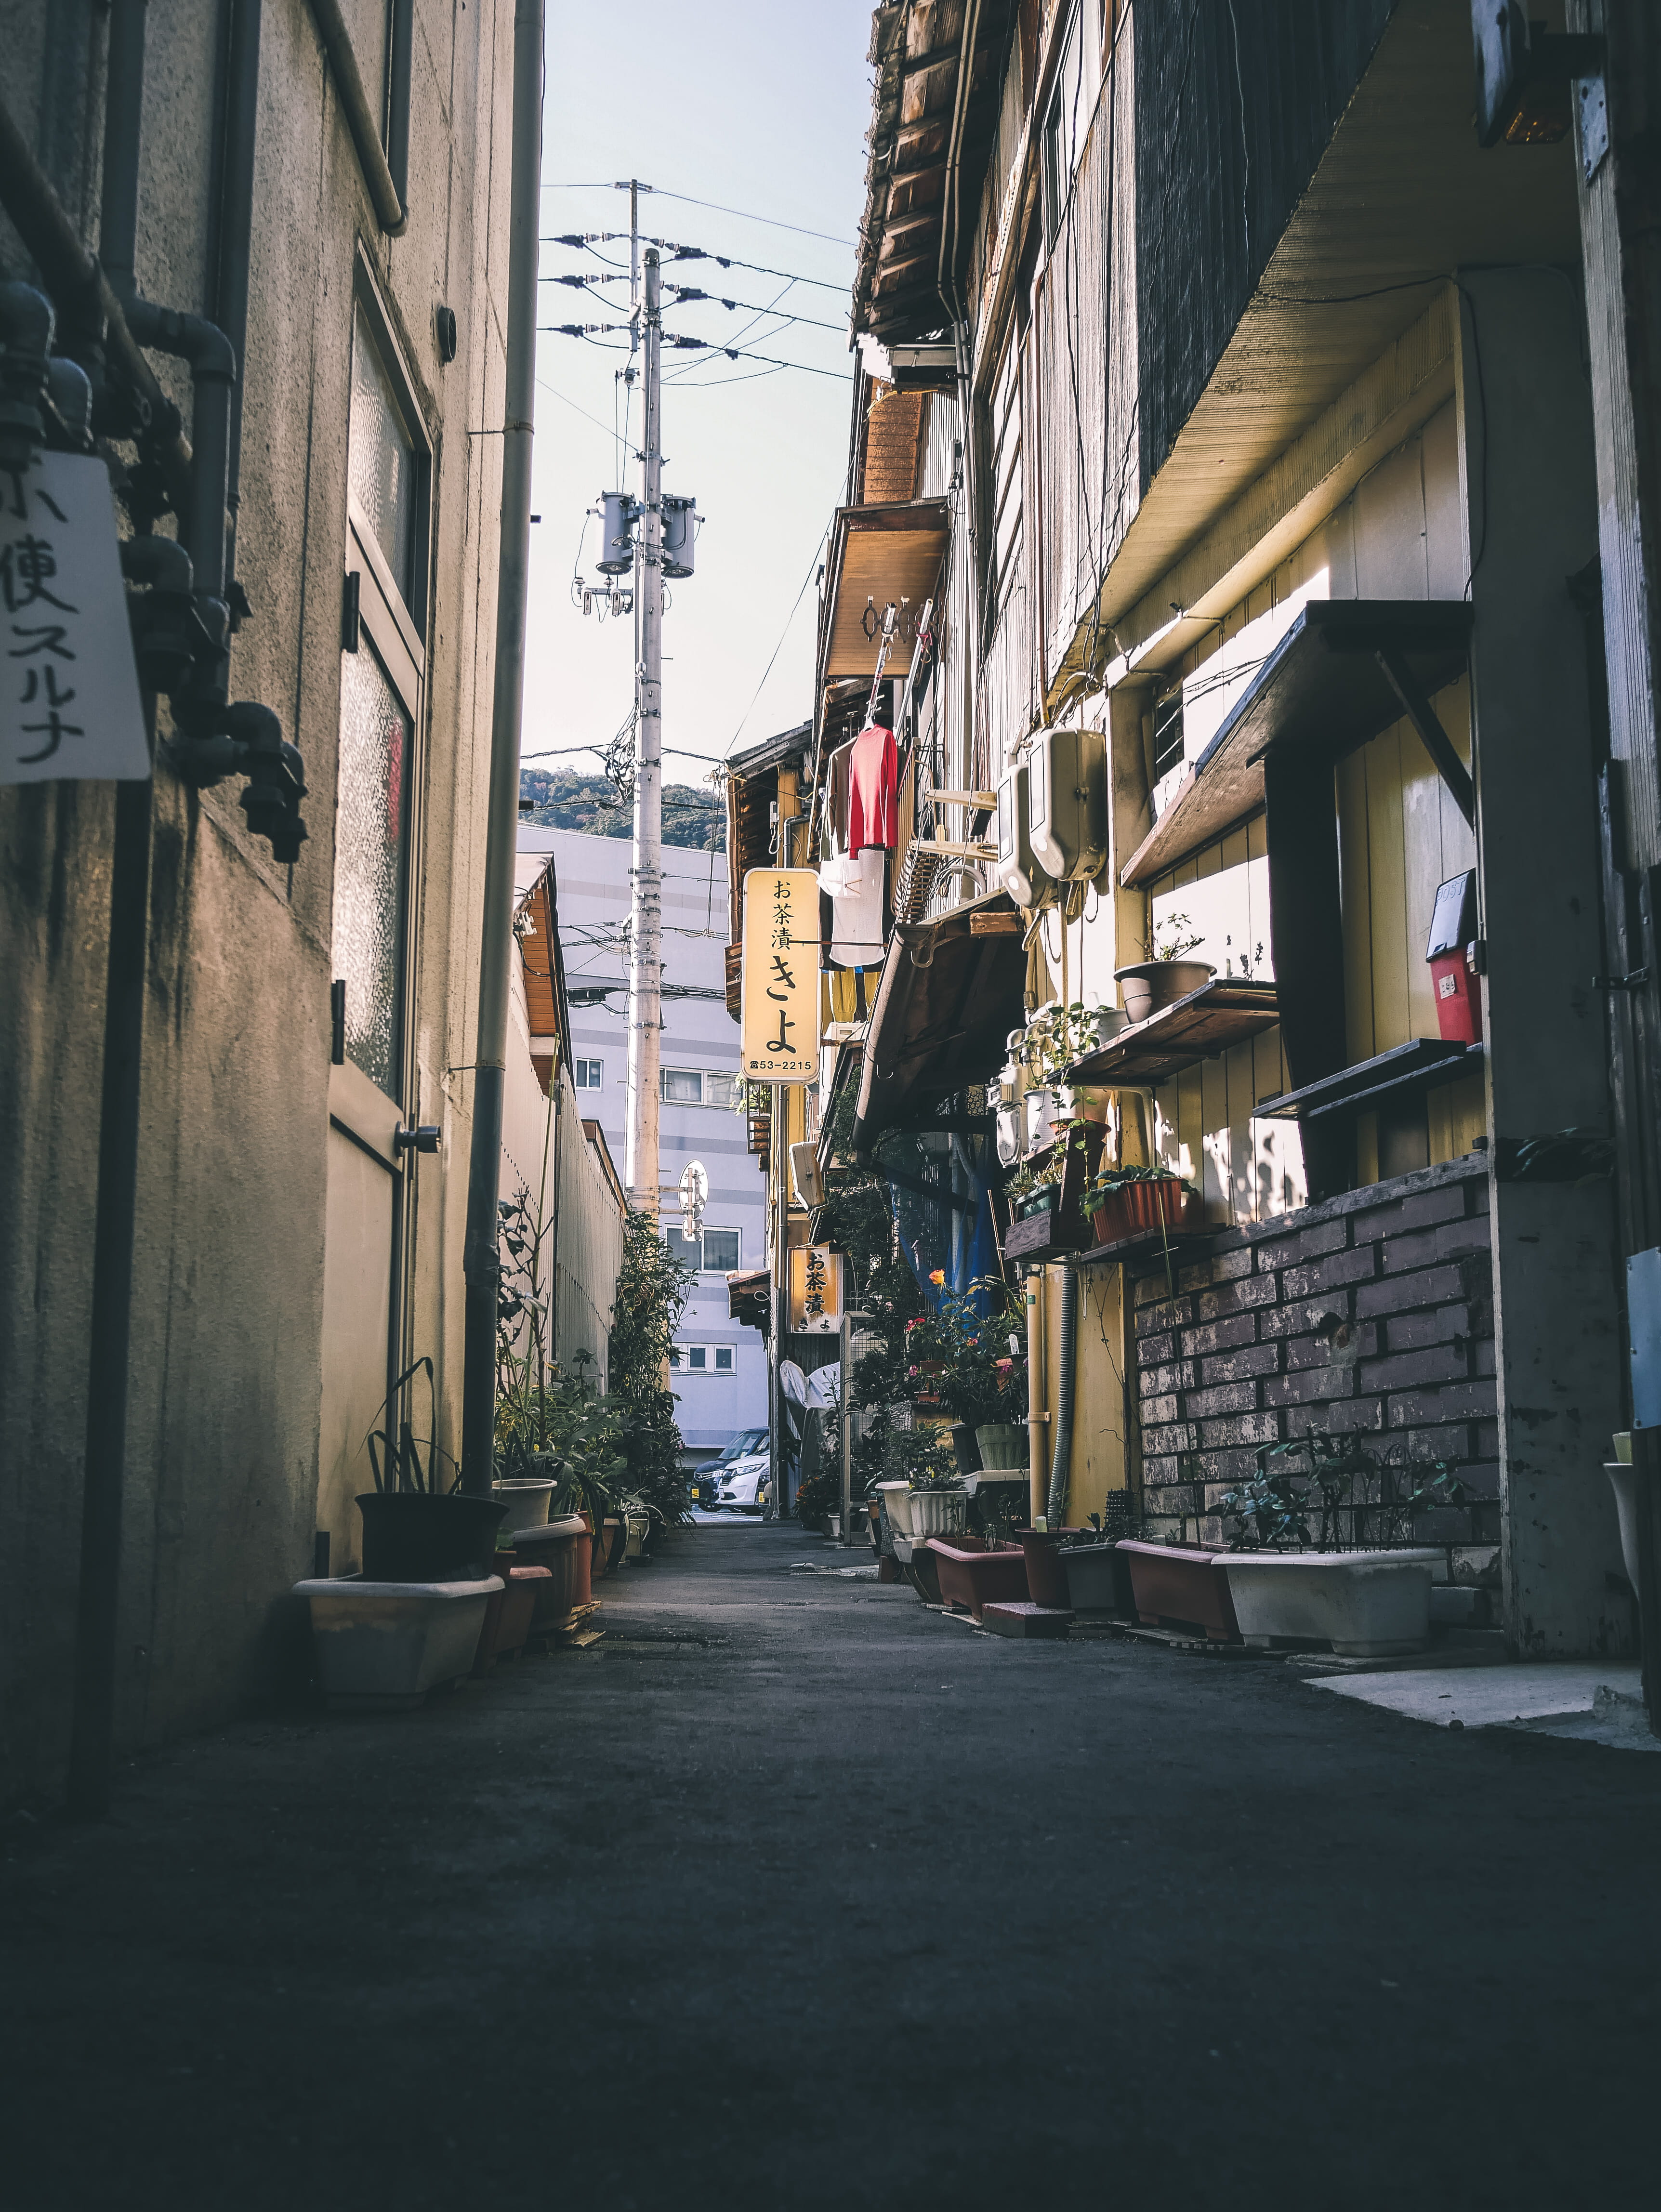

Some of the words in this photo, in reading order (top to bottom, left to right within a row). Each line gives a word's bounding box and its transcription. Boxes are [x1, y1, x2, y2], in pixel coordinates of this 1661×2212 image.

[1436, 877, 1465, 906] POST
[804, 1253, 827, 1315] お茶漬
